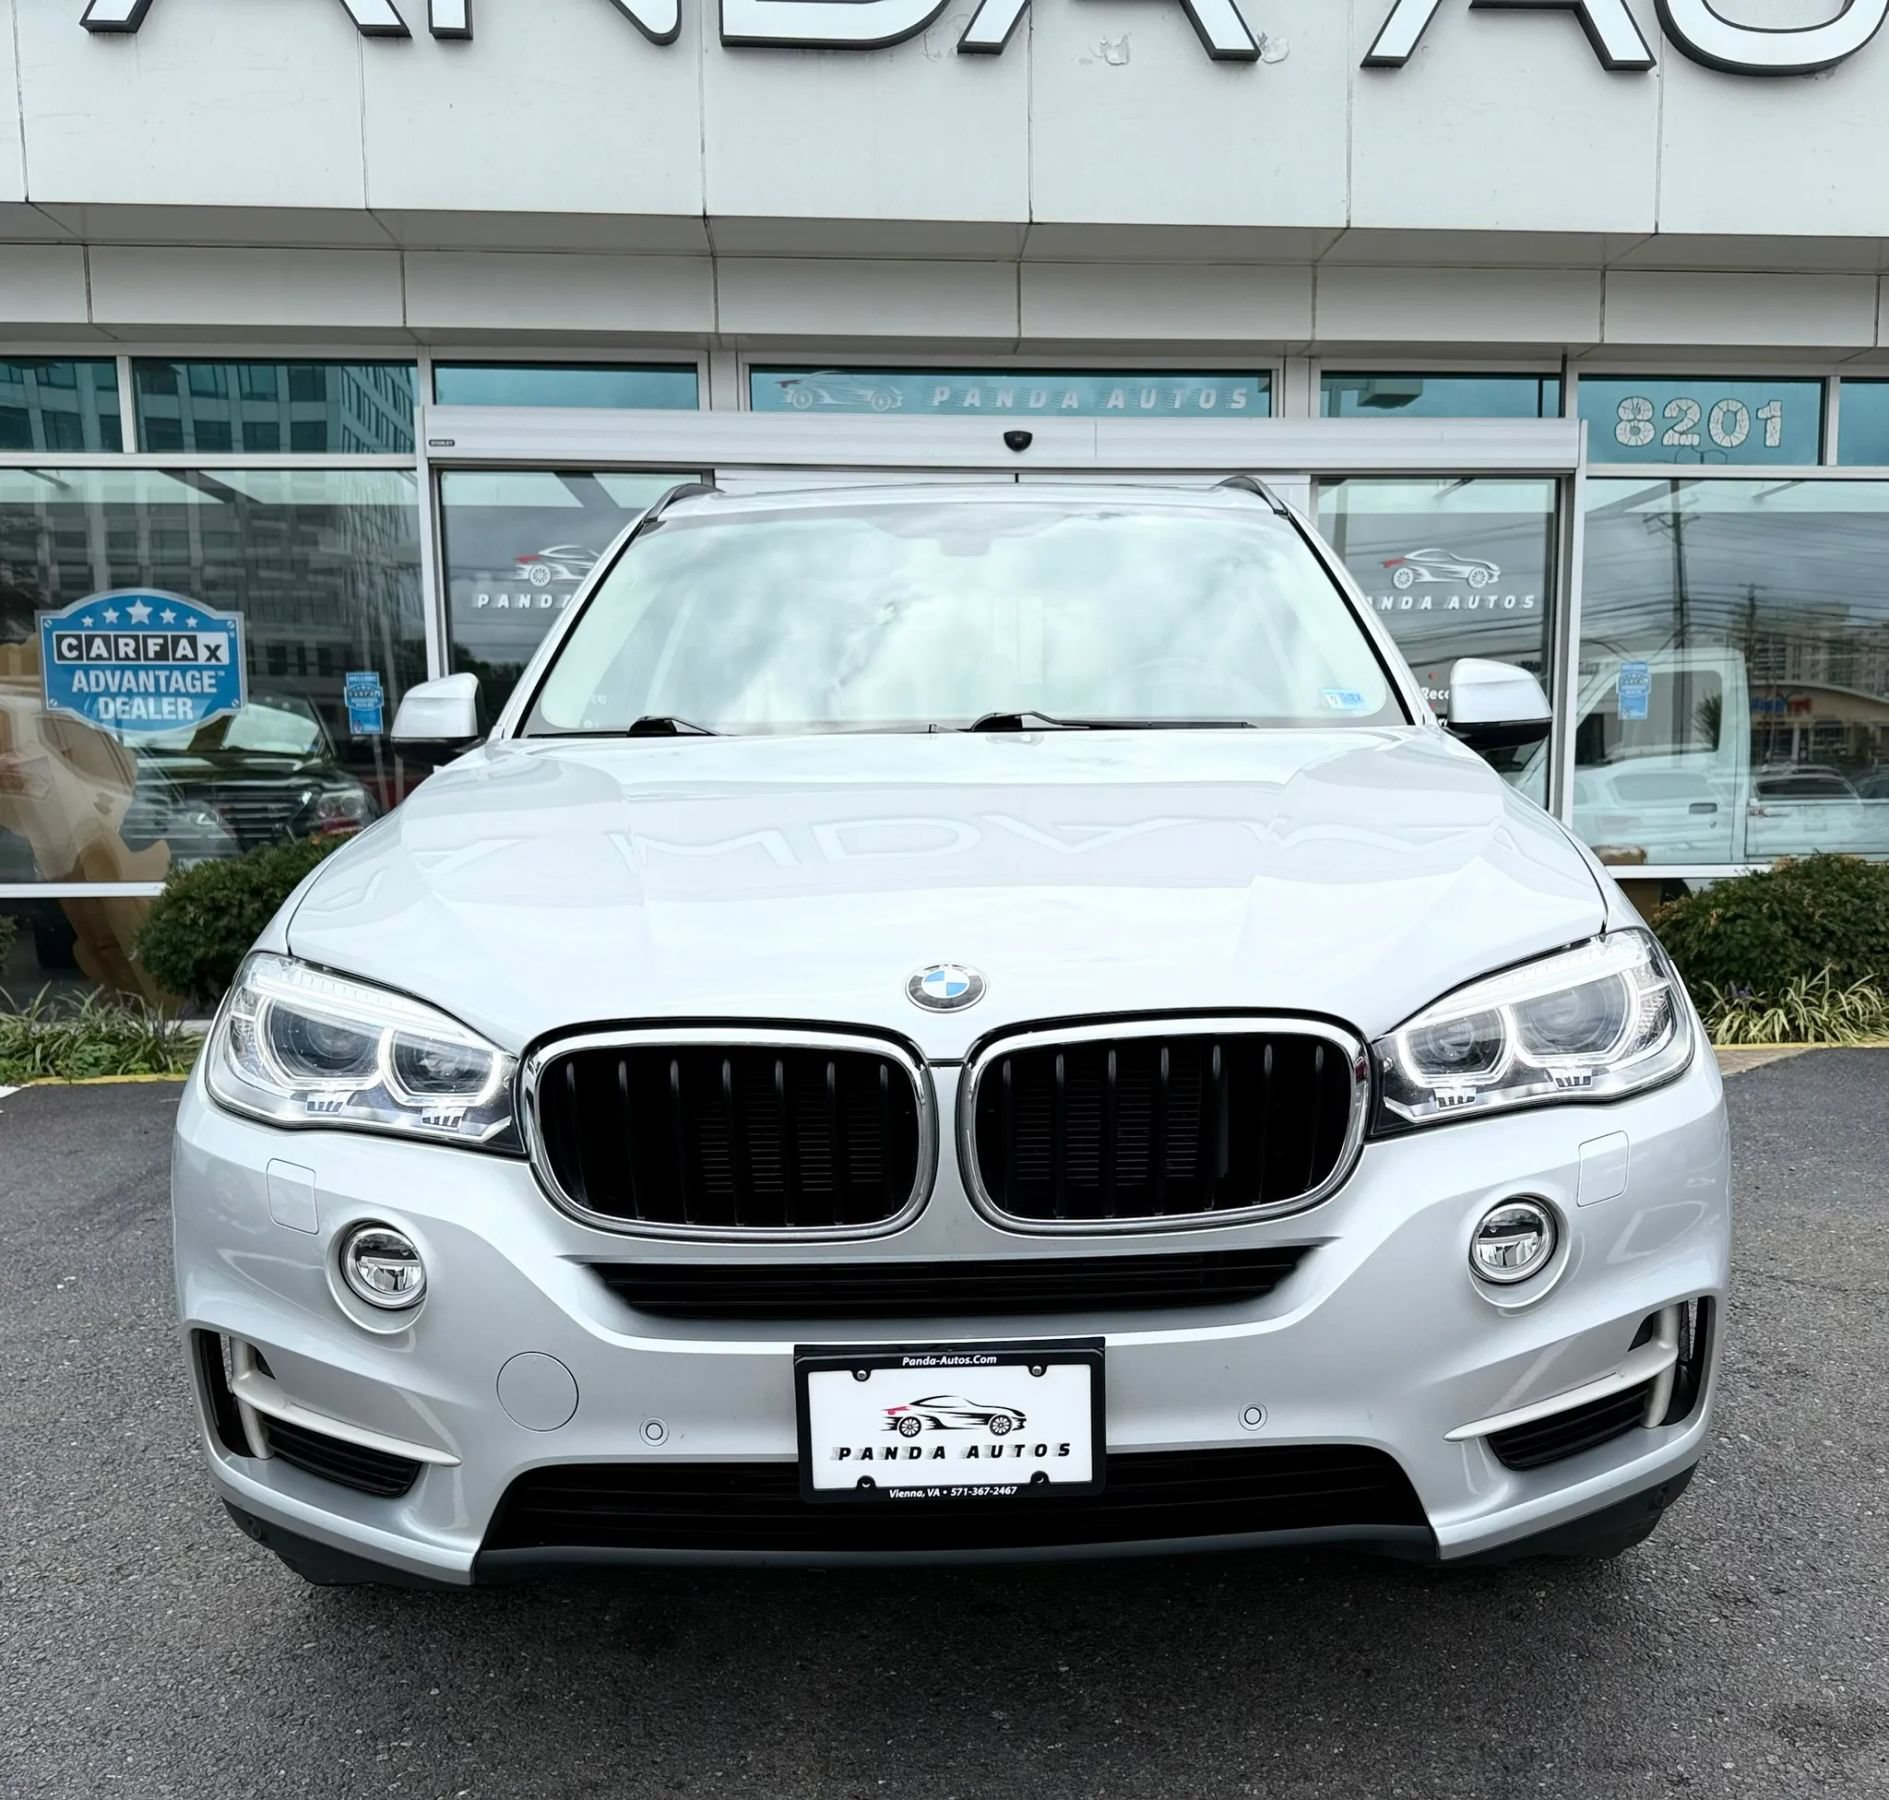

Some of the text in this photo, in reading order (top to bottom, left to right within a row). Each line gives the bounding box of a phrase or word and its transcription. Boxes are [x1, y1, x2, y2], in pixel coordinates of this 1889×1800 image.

[932, 386, 1247, 409] PANDA AUTOS
[1614, 396, 1783, 448] 8201
[1448, 594, 1535, 609] AUTOS
[59, 636, 223, 663] CARFAX
[98, 696, 194, 720] DEALER
[902, 1354, 997, 1366] Panda-Autos.Com
[837, 1442, 1071, 1461] PANDA AUTOS
[889, 1486, 1018, 1499] Vienna, VA 571-367-2467
